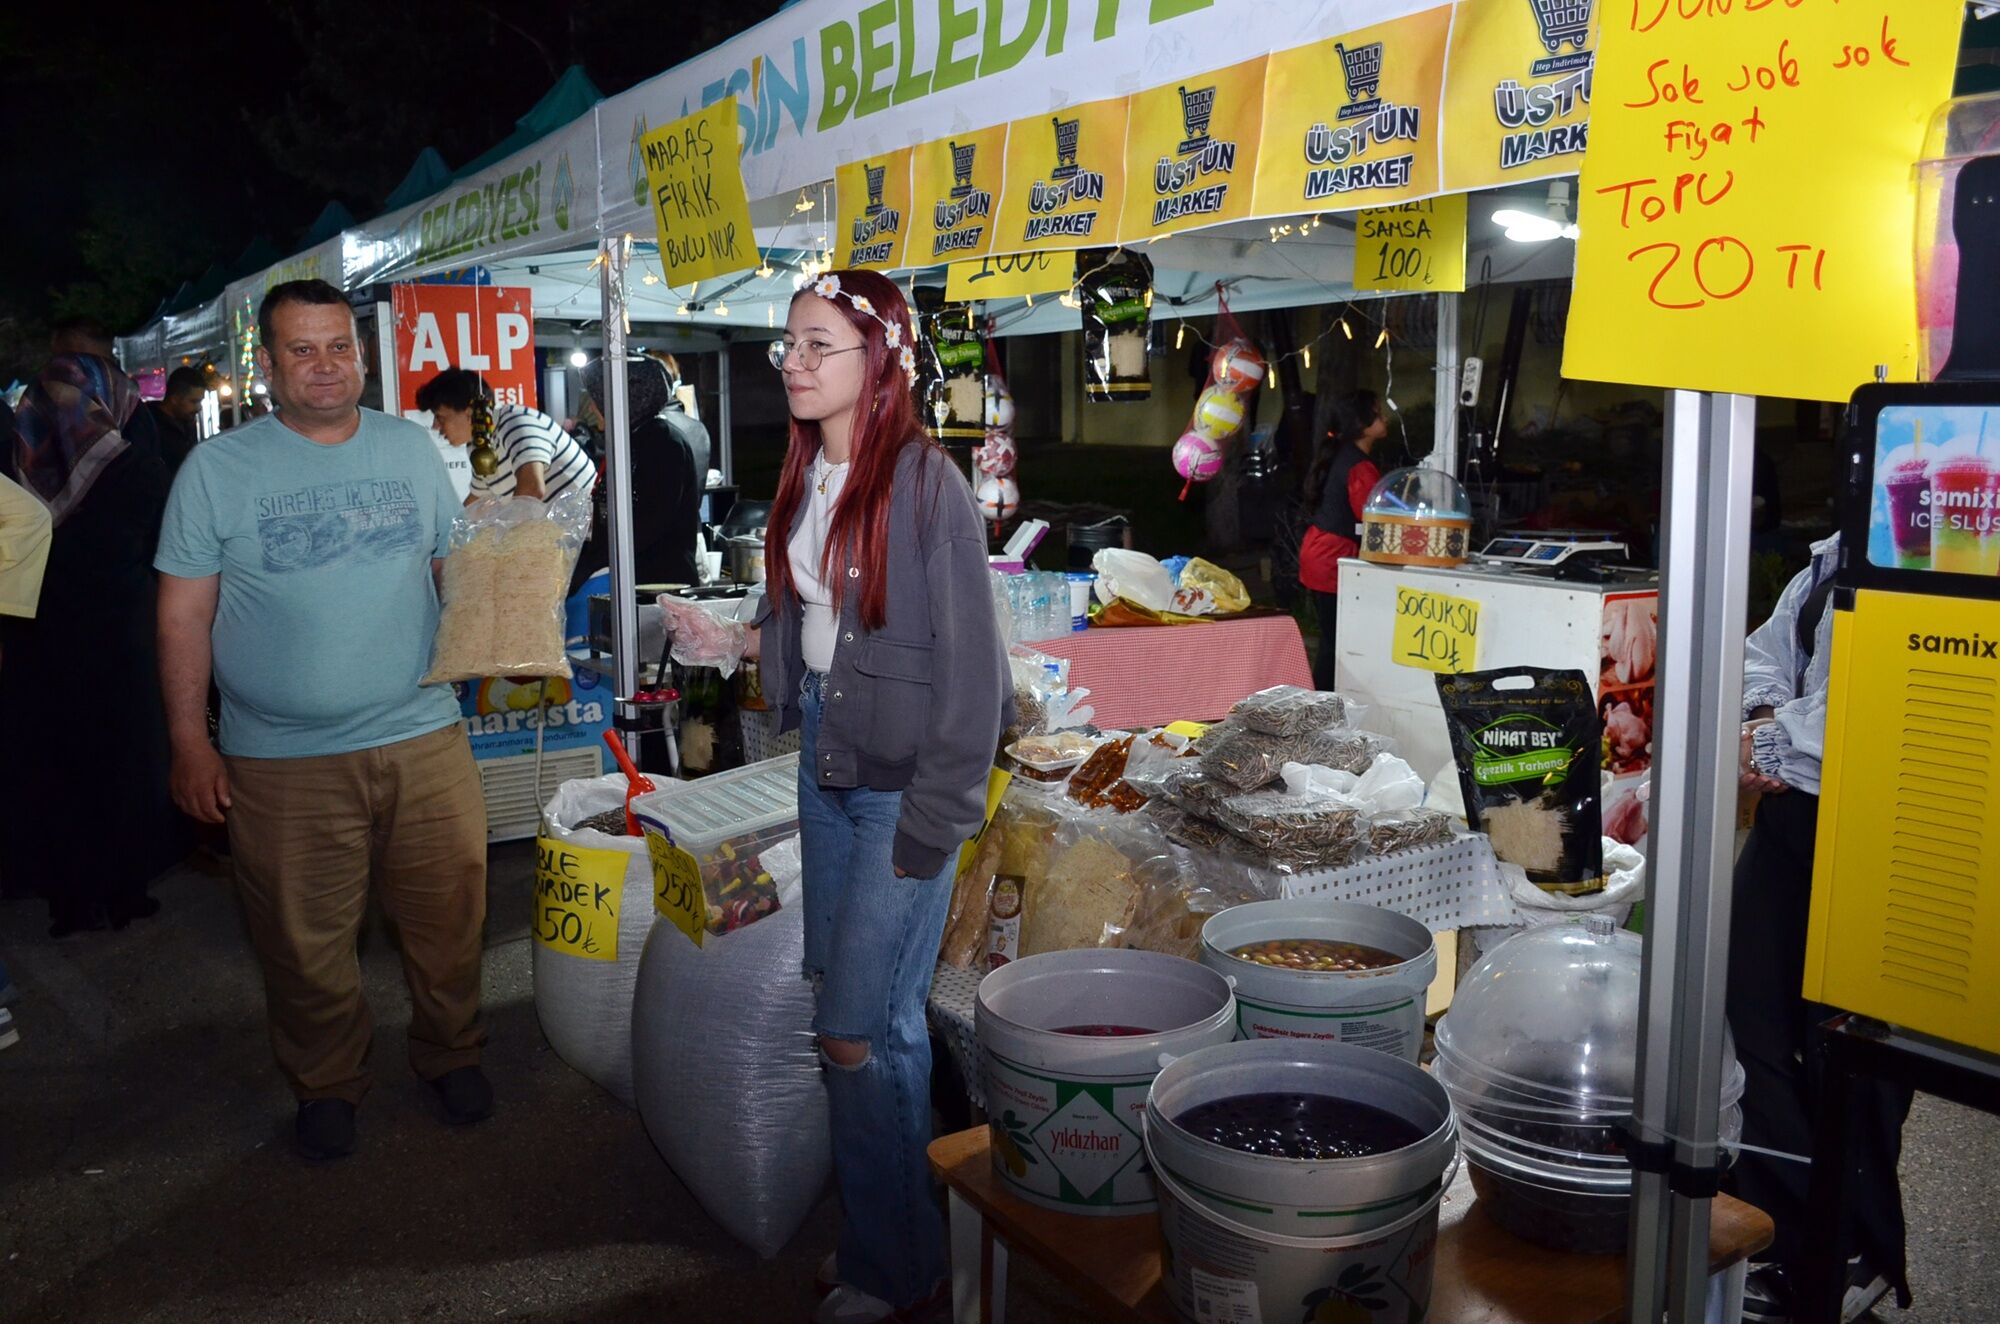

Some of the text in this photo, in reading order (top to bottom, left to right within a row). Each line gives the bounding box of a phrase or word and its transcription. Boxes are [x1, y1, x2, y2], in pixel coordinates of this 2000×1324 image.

[1536, 56, 1588, 73] Hep İndirimde
[1494, 67, 1593, 127] ÜST
[647, 119, 713, 171] MARAŞ
[1305, 102, 1420, 163] ÜSTÜN
[1501, 122, 1588, 168] MARK
[1154, 139, 1236, 194] ÜSTÜN
[1304, 153, 1414, 199] MARKET
[657, 166, 720, 232] FİRİK
[934, 188, 991, 230] ÜSTÜN
[1029, 168, 1104, 214] ÜSTÜN
[1152, 183, 1228, 226] MARKET
[416, 160, 542, 266] BELEDİYESİ
[853, 206, 900, 245] ÜSTÜN
[1024, 210, 1097, 241] MARKET
[1363, 218, 1432, 239] SAMSA
[850, 242, 893, 268] MARKET
[933, 227, 983, 256] MARKET
[1627, 236, 1755, 310] 20
[409, 312, 530, 372] ALP
[494, 383, 524, 405] ESİ
[371, 480, 414, 503] CUBA
[1911, 512, 1945, 528] ICE
[1483, 727, 1556, 747] NİHAT BEY
[1518, 758, 1564, 772] Tarhana
[1051, 1127, 1119, 1153] yıldızhan
